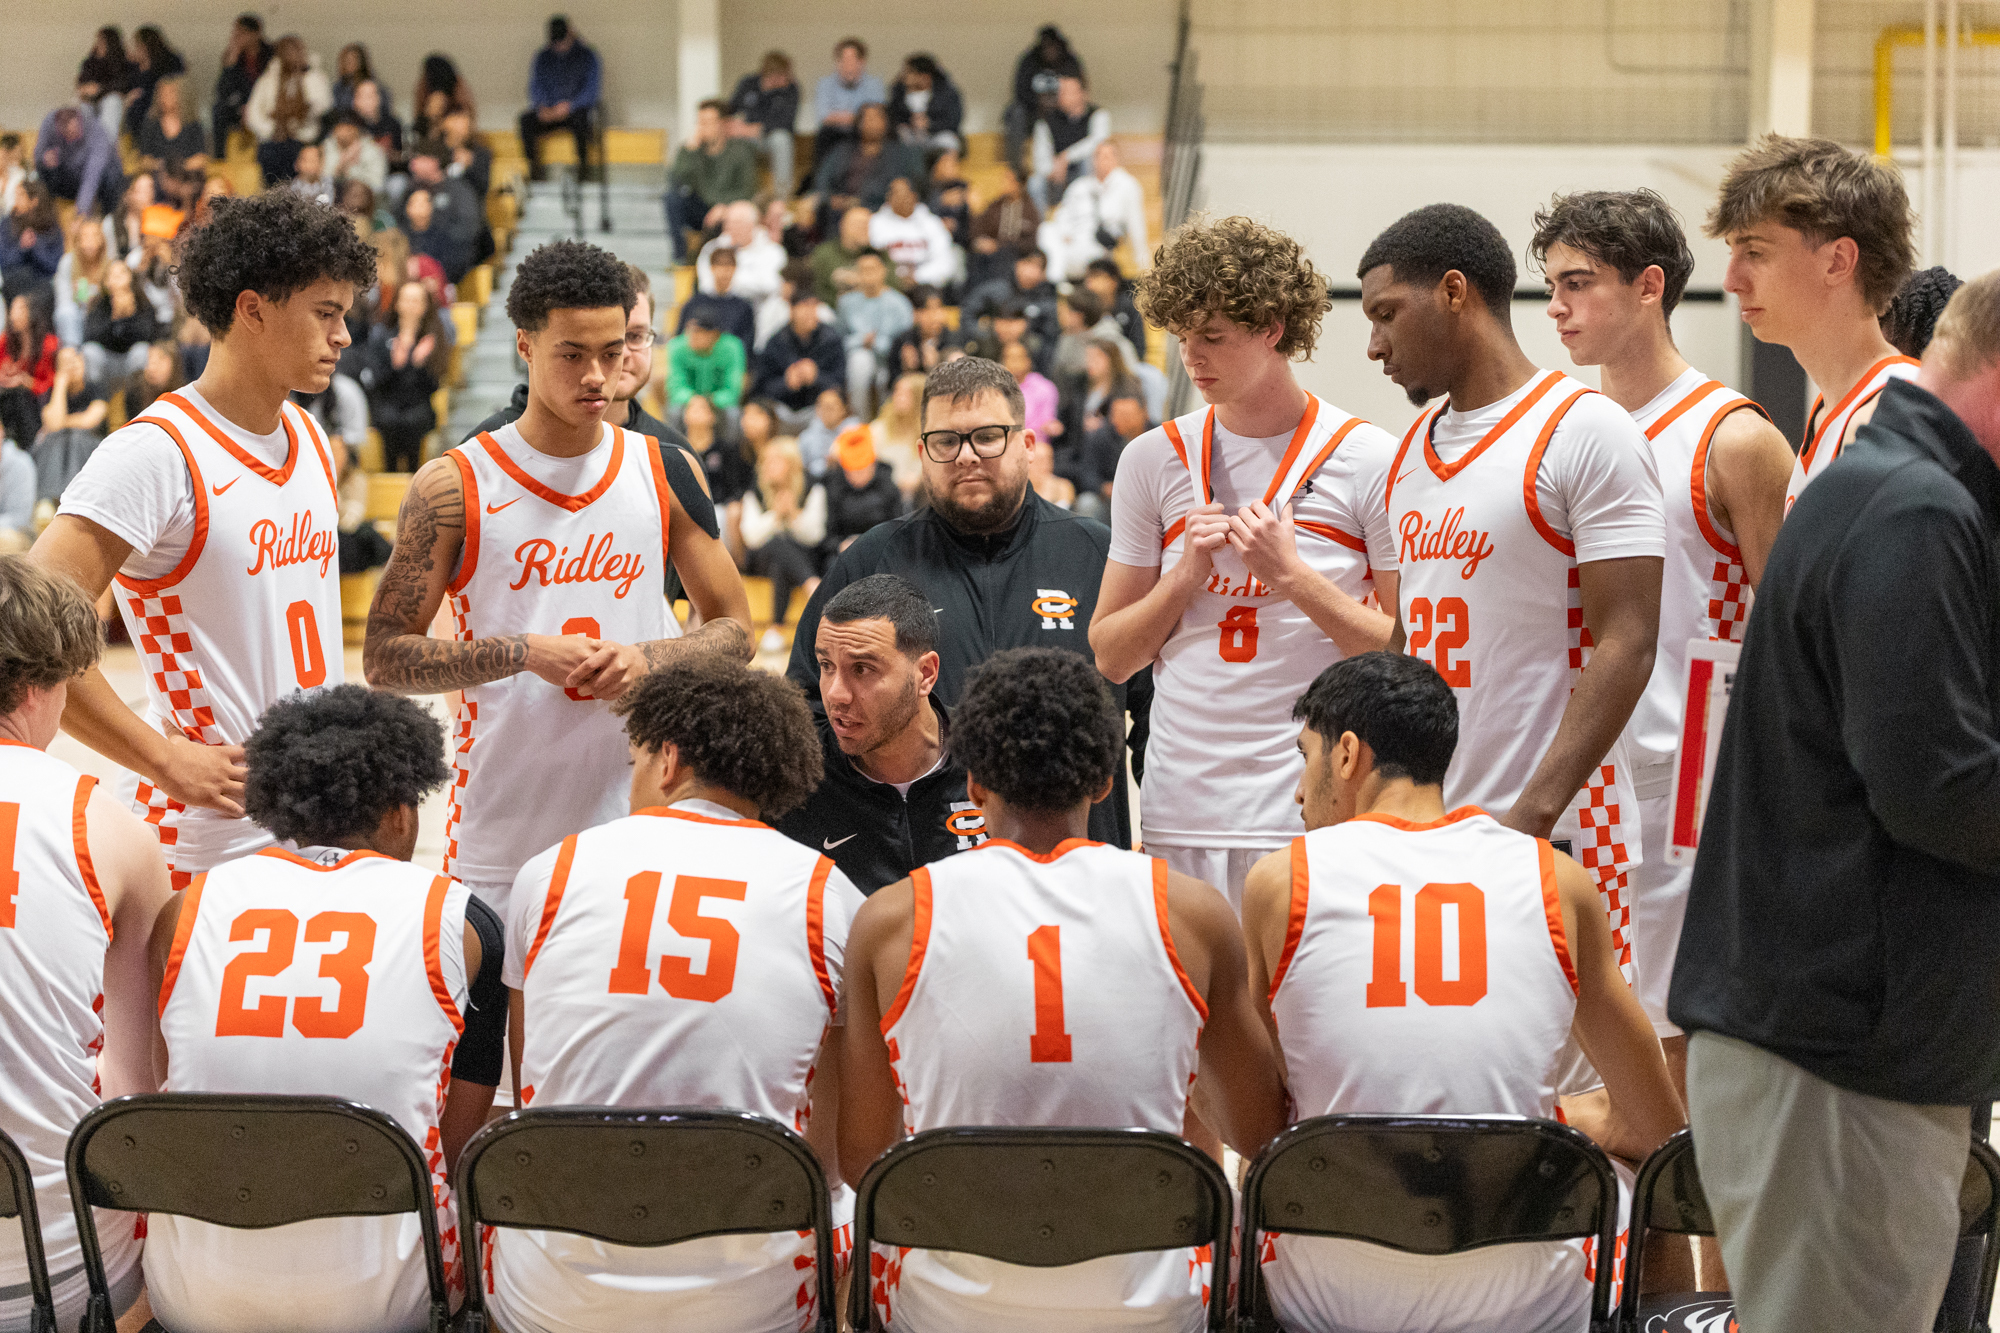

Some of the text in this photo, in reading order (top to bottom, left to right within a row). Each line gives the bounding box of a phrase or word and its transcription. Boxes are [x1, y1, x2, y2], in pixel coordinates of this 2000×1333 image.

[247, 509, 336, 579] Ridley
[510, 532, 645, 600] Ridley
[1399, 506, 1494, 580] Ridley
[285, 599, 327, 690] 0
[471, 641, 529, 676] GOD
[1409, 597, 1472, 688] 22
[215, 909, 377, 1039] 23
[608, 870, 747, 1003] 15
[1366, 882, 1487, 1008] 10
[1027, 925, 1072, 1063] 1
